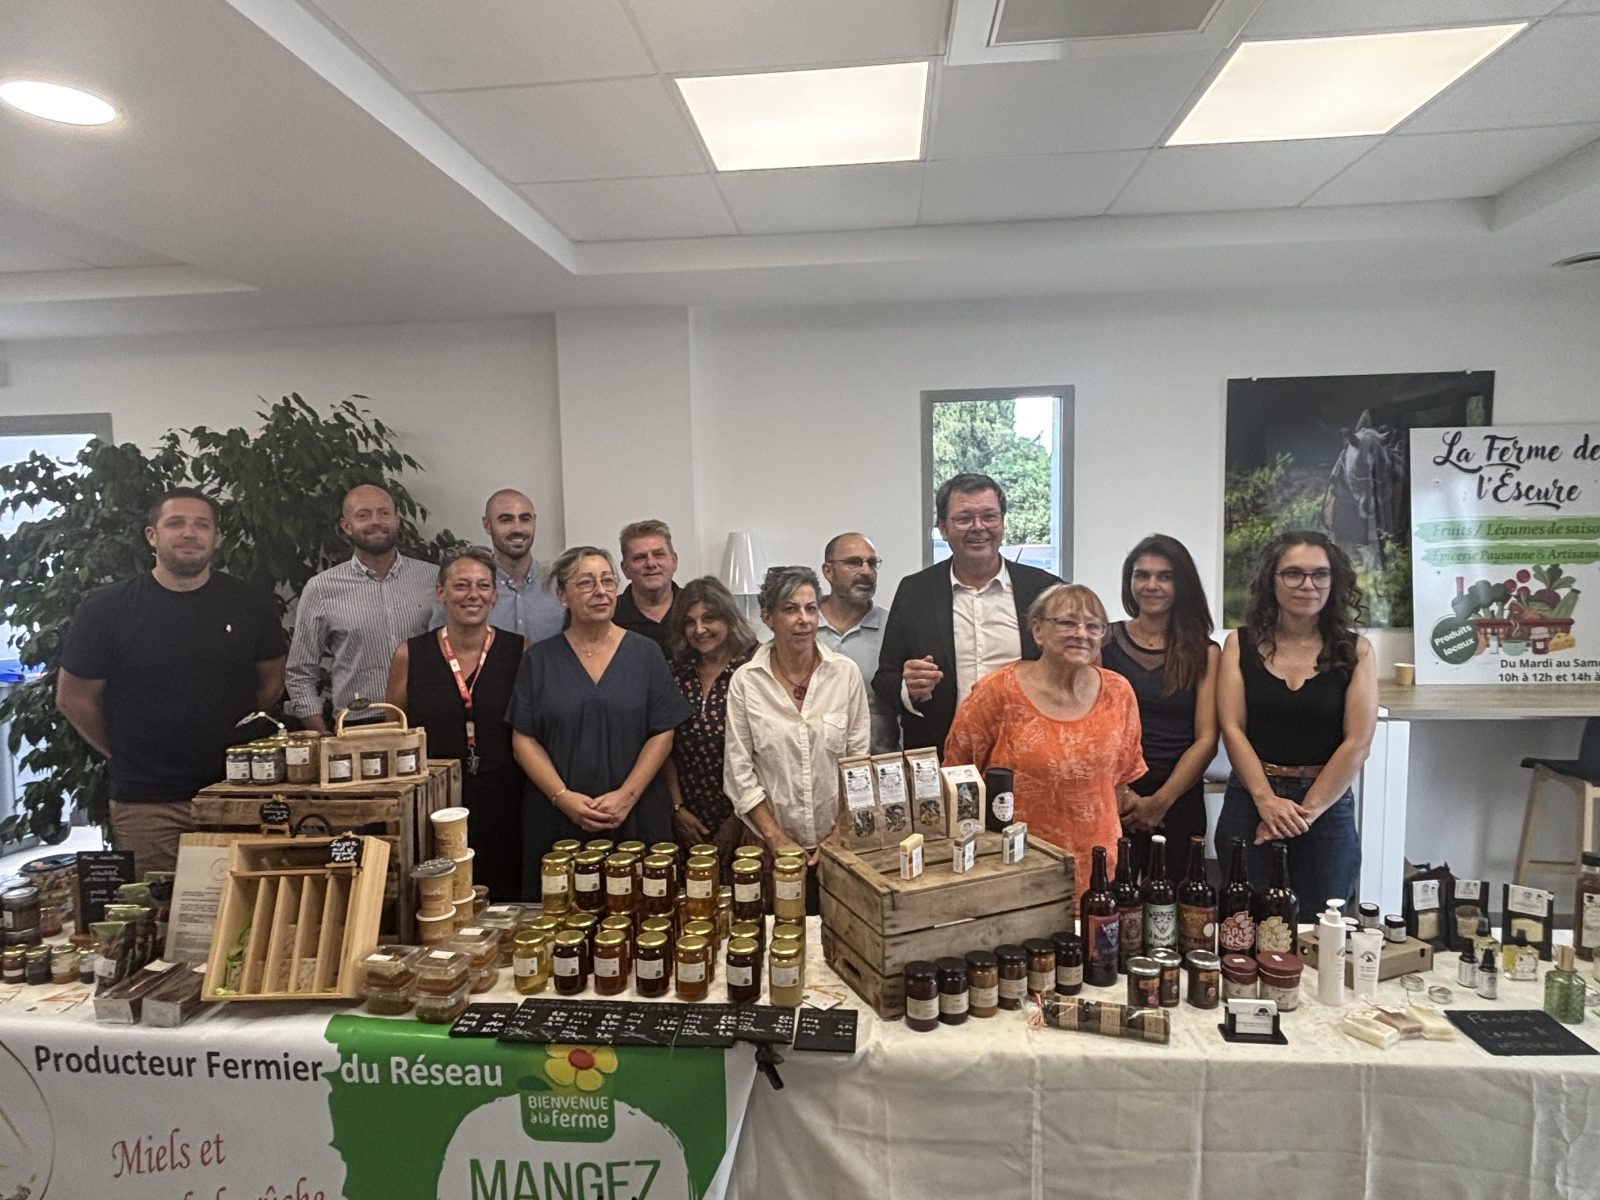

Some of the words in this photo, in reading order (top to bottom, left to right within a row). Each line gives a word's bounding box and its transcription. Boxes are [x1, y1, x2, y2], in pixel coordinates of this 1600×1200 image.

[1433, 430, 1483, 474] La
[1483, 434, 1563, 471] Ferme
[1573, 433, 1600, 461] de
[1432, 523, 1473, 537] Fruits
[1486, 522, 1546, 540] Légumes
[1547, 521, 1564, 535] de
[1480, 549, 1535, 565] Paysanne
[1536, 548, 1545, 560] &
[1433, 624, 1473, 647] Produits
[1442, 637, 1476, 656] locaux
[1500, 659, 1516, 668] Du
[1519, 658, 1553, 668] Mardi
[1555, 659, 1570, 668] au
[1498, 673, 1519, 682] 10h
[1521, 672, 1529, 682] à
[1532, 672, 1553, 682] 12h
[1555, 672, 1567, 682] et
[1571, 672, 1592, 682] 14h
[34, 1045, 197, 1078] Producteur
[206, 1051, 322, 1082] Fermier
[341, 1054, 378, 1084] du
[390, 1056, 502, 1087] Réseau
[528, 1095, 609, 1110] BIENVENUE
[530, 1112, 537, 1124] à
[538, 1112, 550, 1124] la
[552, 1109, 608, 1129] ferme
[112, 1128, 190, 1178] Miels
[200, 1133, 226, 1167] et
